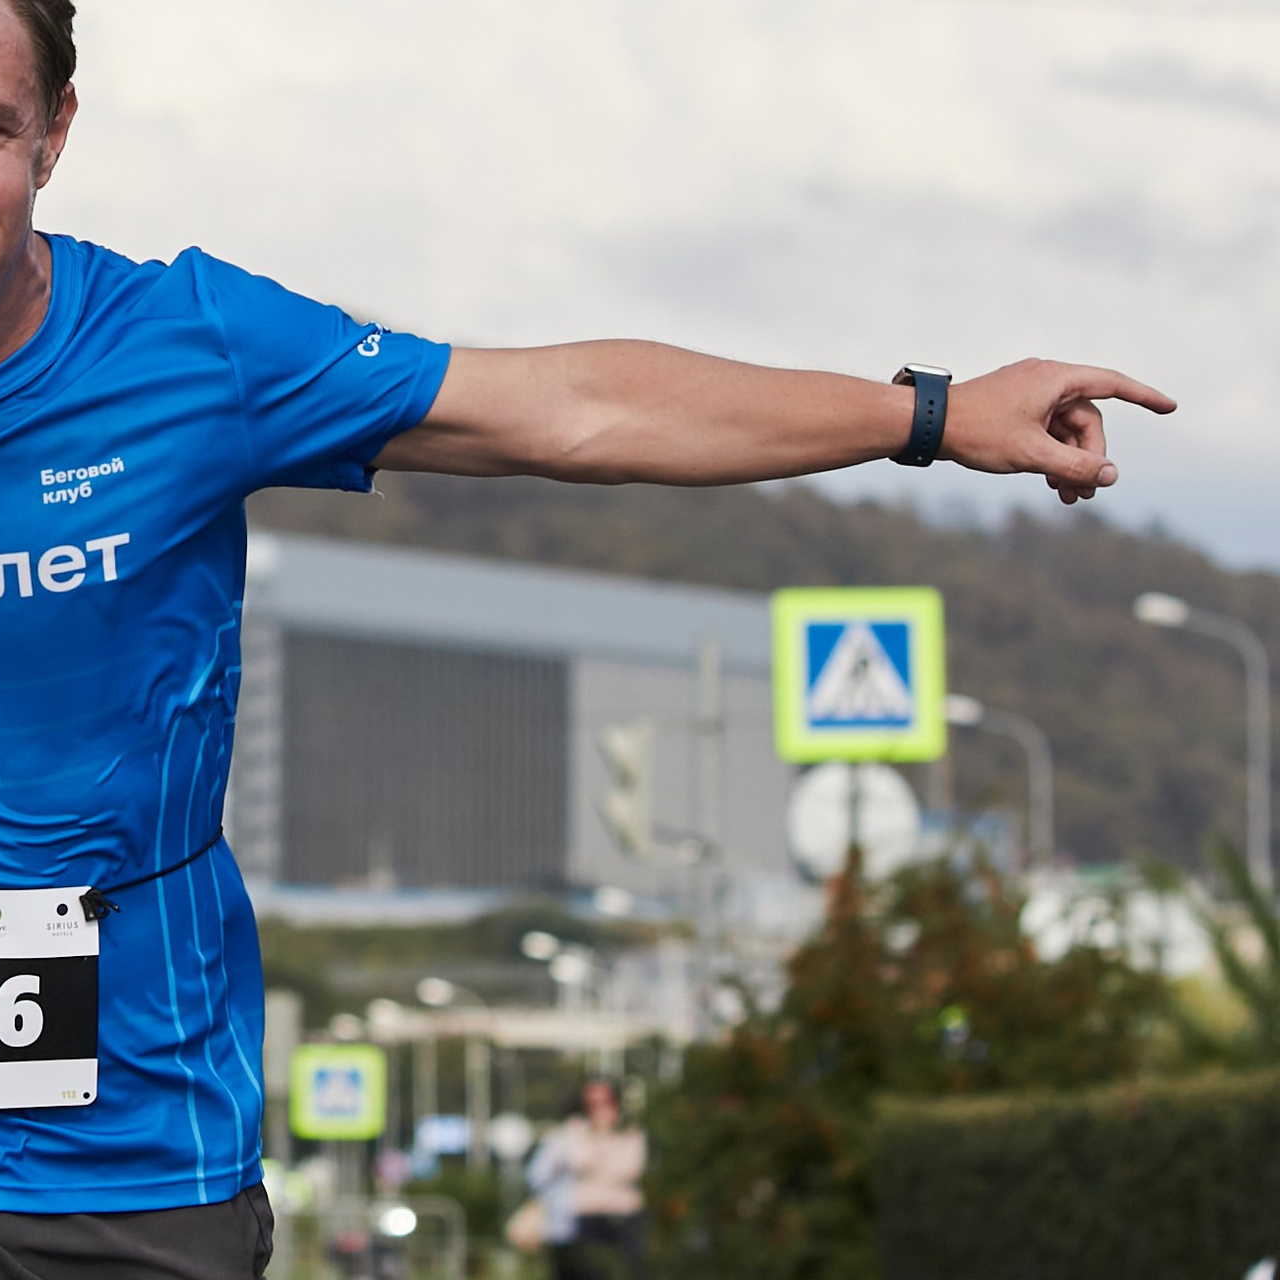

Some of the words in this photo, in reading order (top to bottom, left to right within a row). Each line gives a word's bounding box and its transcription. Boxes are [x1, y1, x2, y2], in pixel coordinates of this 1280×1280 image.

[40, 457, 125, 486] Беговой
[42, 481, 93, 504] клуб
[46, 921, 79, 931] SIRIUS
